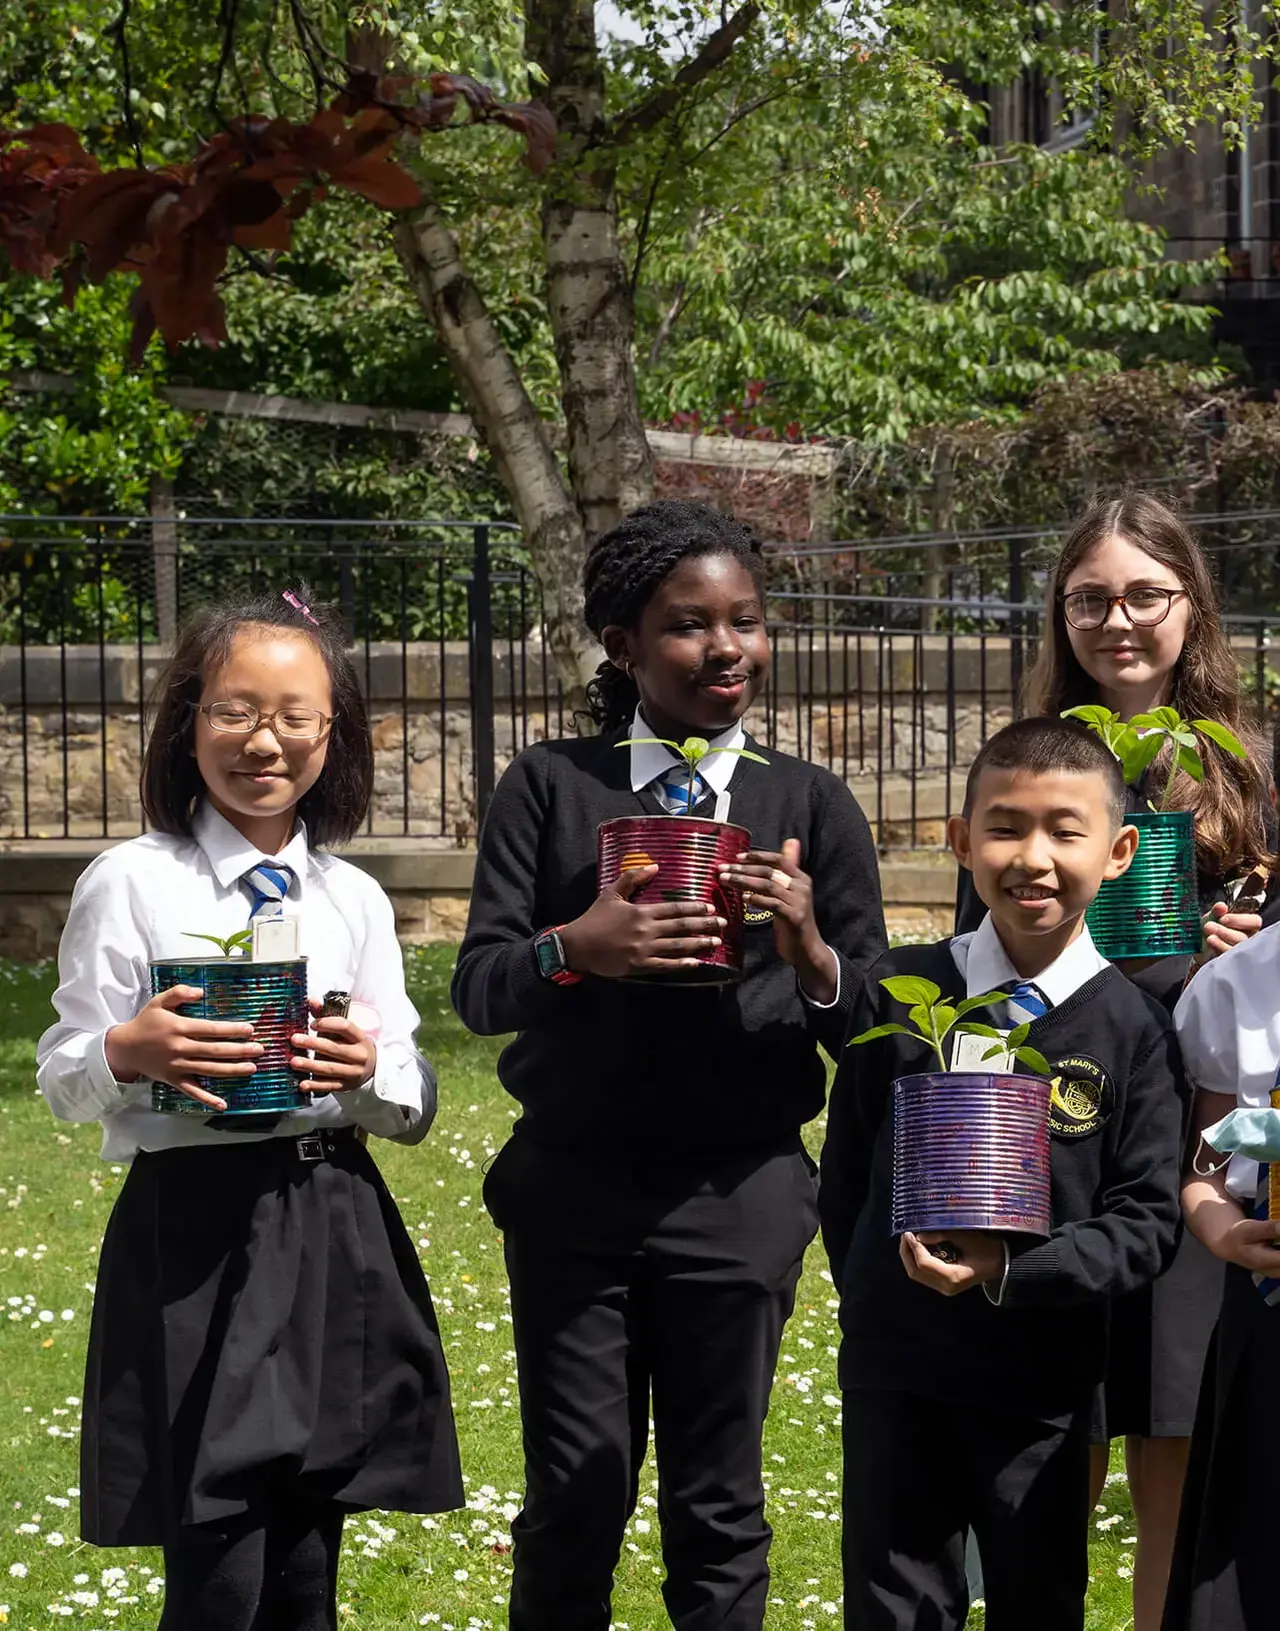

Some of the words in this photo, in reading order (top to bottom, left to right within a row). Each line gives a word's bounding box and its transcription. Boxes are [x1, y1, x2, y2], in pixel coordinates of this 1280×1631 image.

[744, 911, 774, 921] SCHOO
[1058, 1060, 1069, 1068] ST
[1070, 1059, 1100, 1076] MARY'S
[1063, 1120, 1097, 1133] SCHOOL
